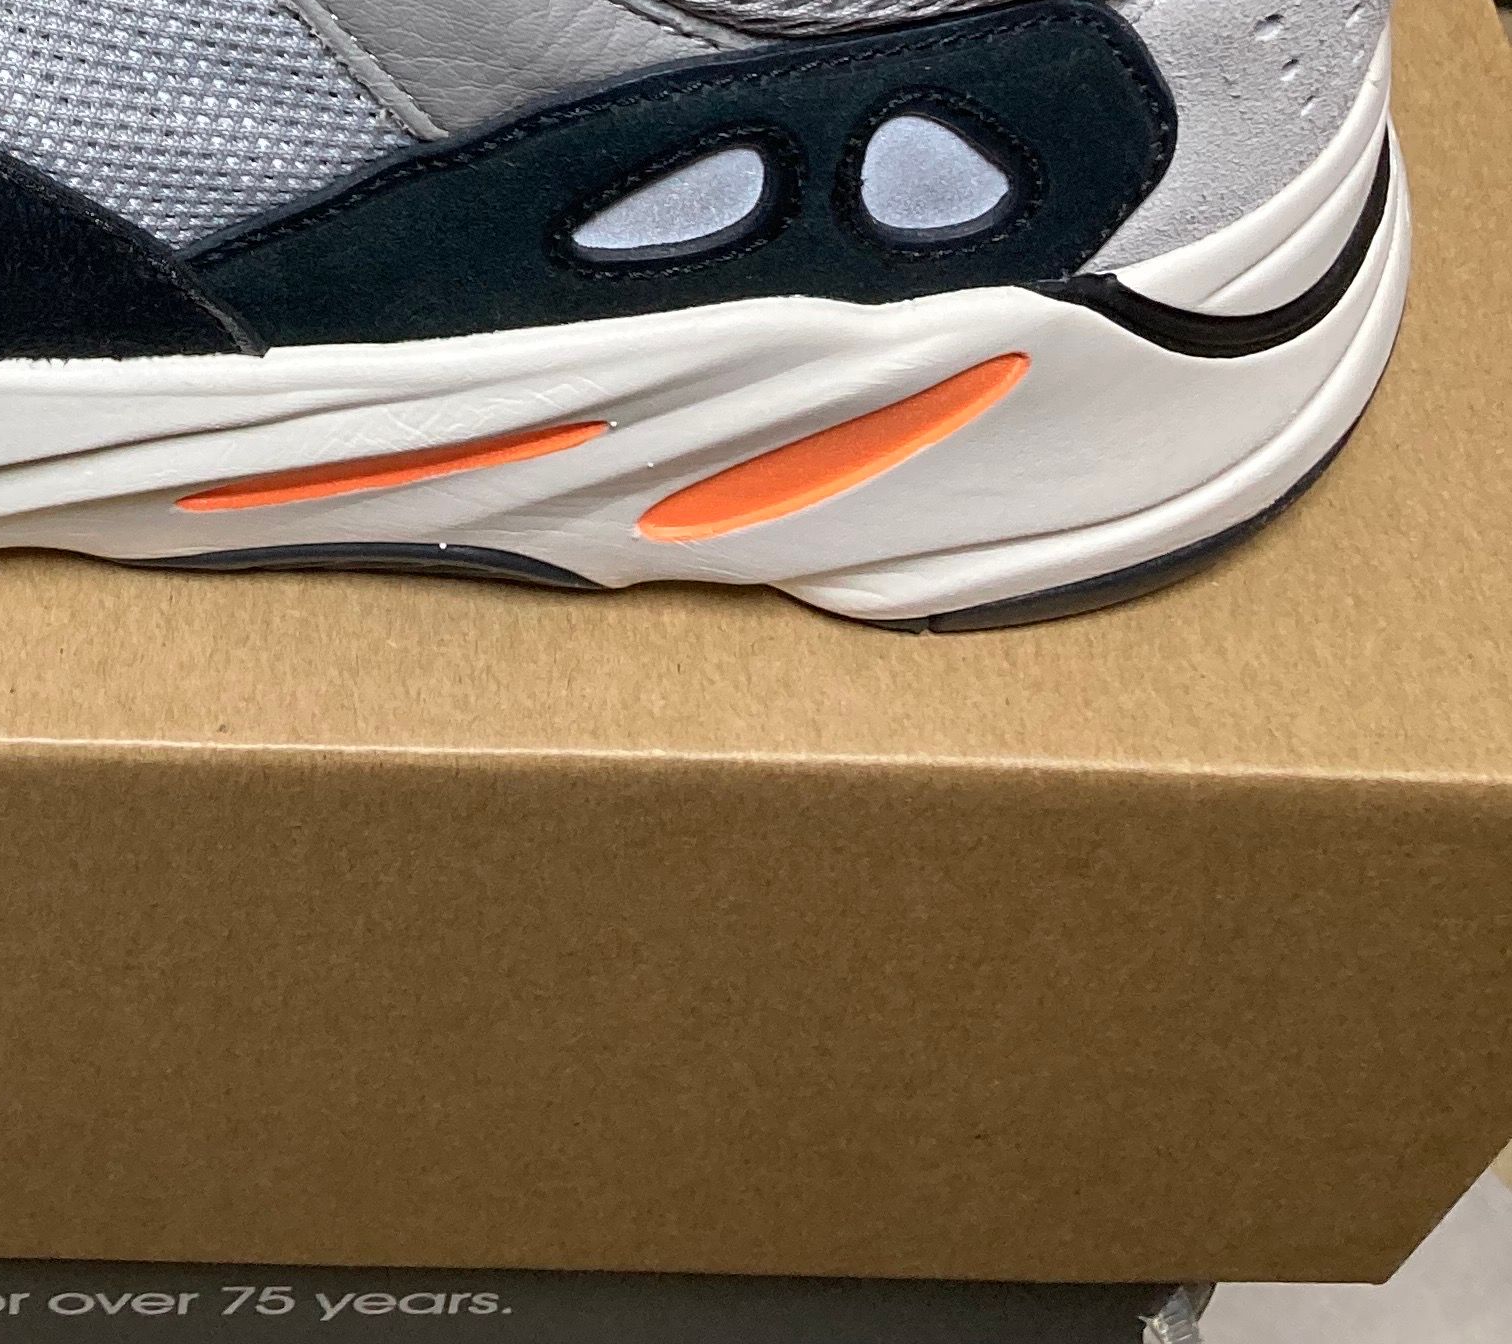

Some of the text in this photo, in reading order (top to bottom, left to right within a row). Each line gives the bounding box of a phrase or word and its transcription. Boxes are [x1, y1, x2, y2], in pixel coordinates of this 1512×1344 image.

[48, 1292, 200, 1316] over
[220, 1286, 295, 1316] 75
[314, 1292, 512, 1322] years.
